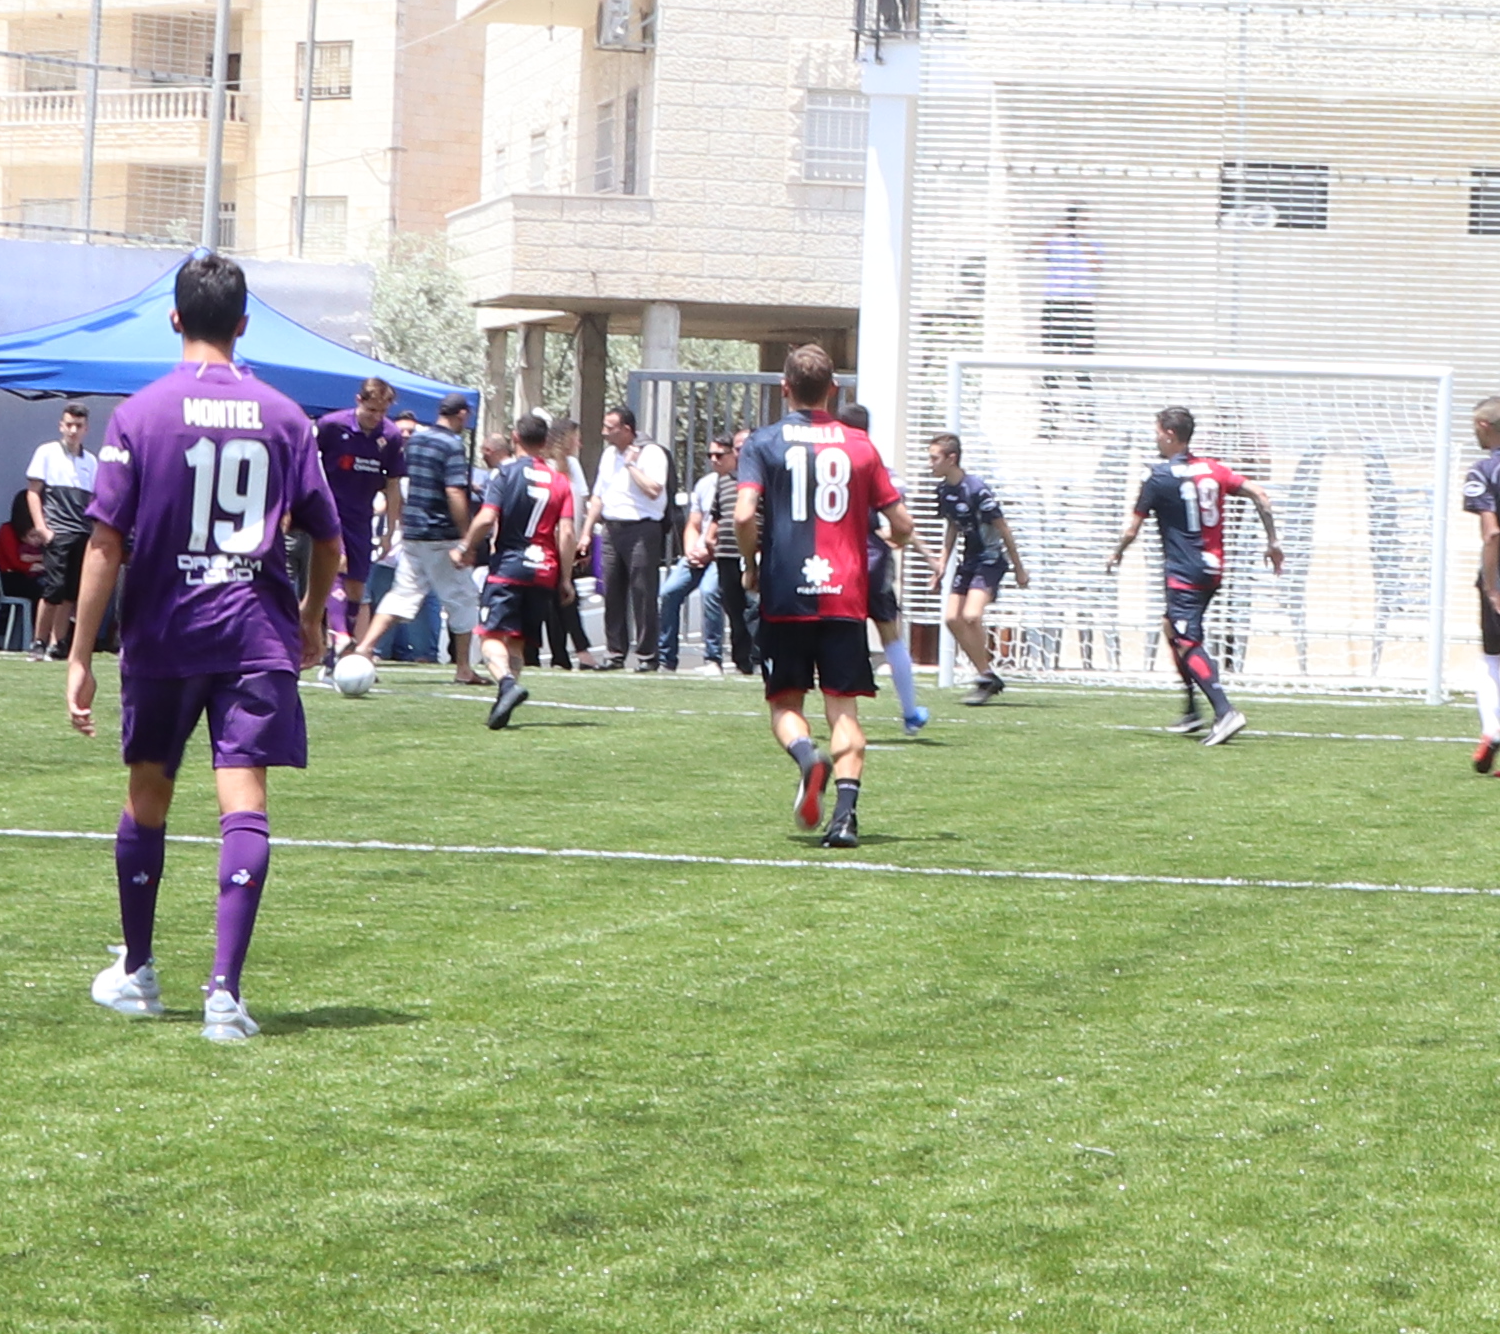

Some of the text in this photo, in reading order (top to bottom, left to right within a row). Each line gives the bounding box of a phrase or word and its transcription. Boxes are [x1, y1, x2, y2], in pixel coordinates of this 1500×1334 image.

[183, 397, 263, 430] MONTIEL
[184, 436, 270, 554] 19
[785, 445, 851, 523] 18
[1179, 478, 1220, 532] 19
[524, 485, 551, 538] 7
